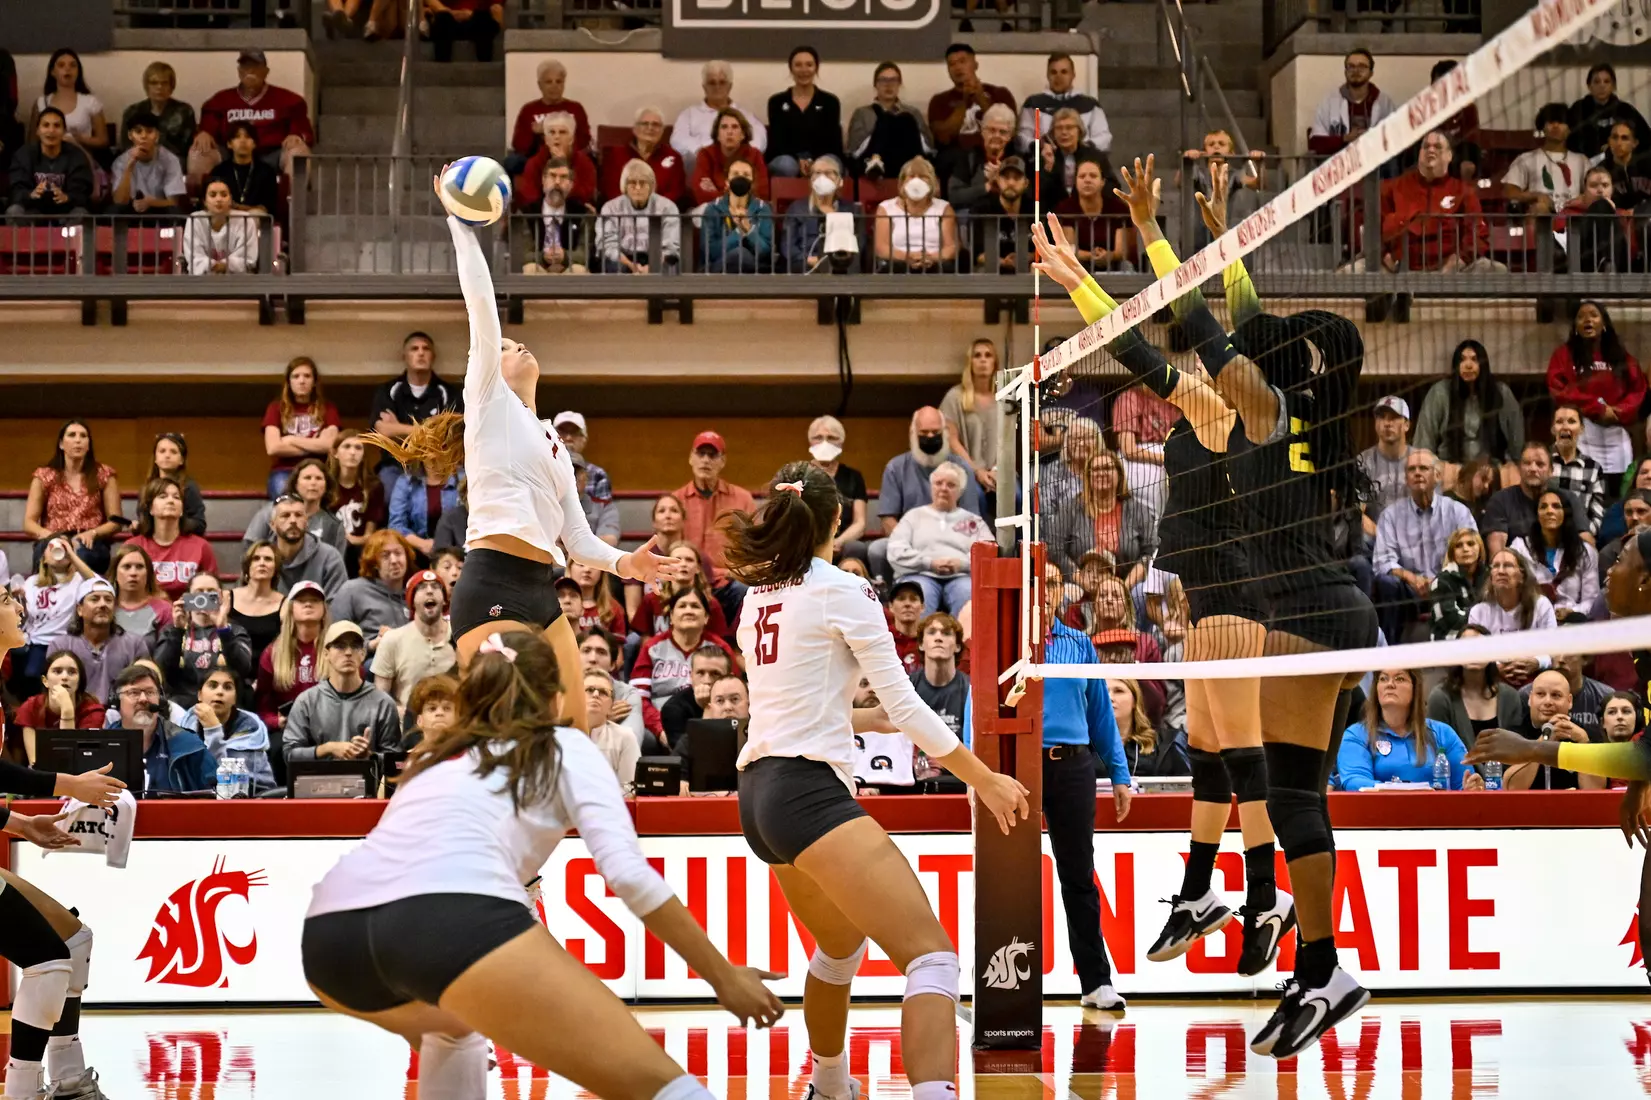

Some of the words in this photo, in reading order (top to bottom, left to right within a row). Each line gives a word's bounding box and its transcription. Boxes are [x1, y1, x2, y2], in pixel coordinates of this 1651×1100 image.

[227, 109, 275, 122] COUGARS
[153, 561, 198, 584] SU
[754, 602, 783, 666] 15
[984, 1029, 1006, 1037] sports
[1007, 1029, 1034, 1037] imports
